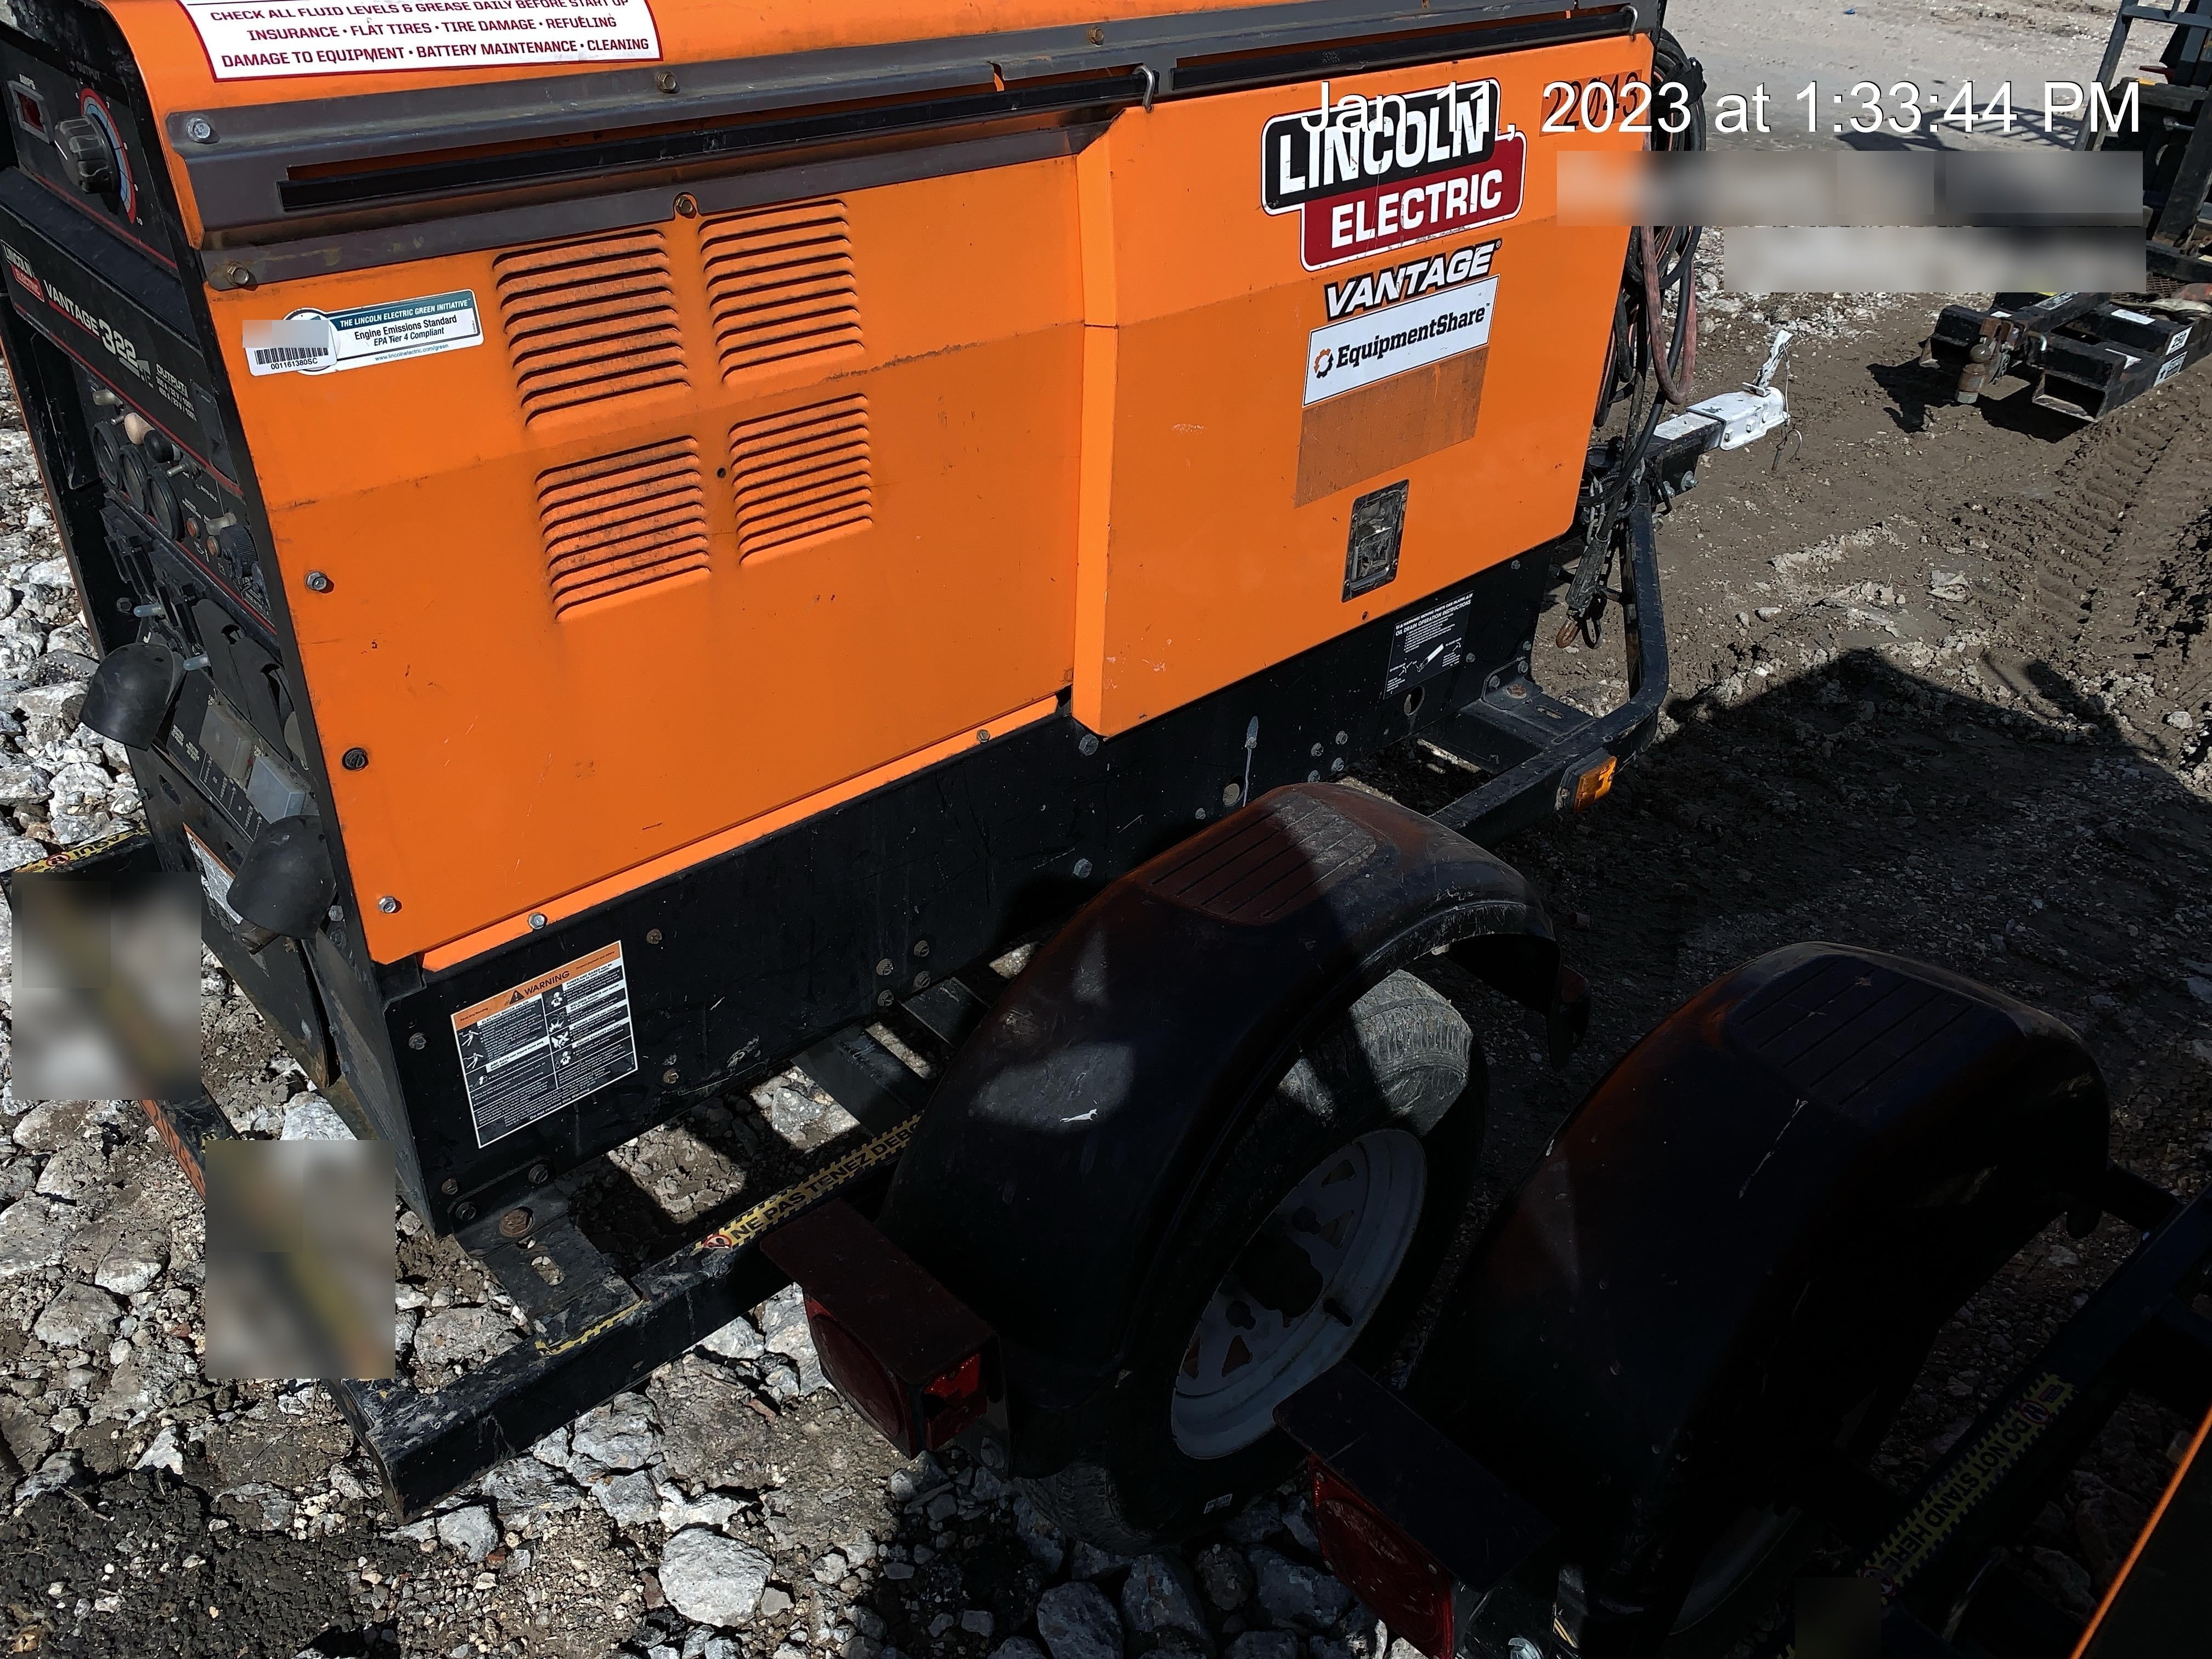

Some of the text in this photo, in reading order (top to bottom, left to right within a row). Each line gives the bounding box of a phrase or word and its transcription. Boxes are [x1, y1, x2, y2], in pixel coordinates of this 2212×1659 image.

[211, 10, 265, 20] CHECK
[269, 8, 296, 19] ALL
[299, 7, 343, 17] FLUID
[347, 4, 399, 15] LEVELS
[402, 3, 413, 12] &
[416, 2, 471, 12] GREASE
[475, 1, 513, 10] DAILY
[517, 0, 567, 8] BEFORE
[247, 17, 617, 41] INSURANCE FLAT TIRES TIRE DAMAGE REFUELING
[222, 38, 649, 67] DAMAGE TO EQUIPMENT BATTERY MAINTENANCE CLEANING
[1279, 98, 1484, 195] LINCOLN
[1331, 169, 1503, 249] ELECTRIC
[1327, 243, 1494, 318] VANTAGE
[43, 279, 139, 369] VANTAGE 322
[340, 300, 468, 328] THE LINCOLN ELECTRIC GREEN INITIATIVE
[355, 328, 381, 341] Engine
[383, 321, 421, 336] Emissions
[423, 315, 457, 329] Standard
[374, 337, 387, 346] EPA
[388, 334, 402, 343] Tier
[410, 327, 444, 341] Compliant
[1336, 306, 1486, 368] EquipmentShare
[156, 363, 186, 393] OUTPUT
[1403, 622, 1417, 633] DRAIN
[1418, 612, 1442, 627] OPERATION
[1442, 599, 1471, 616] INSTRUCTIONS
[524, 969, 570, 996] WARNING
[730, 1215, 765, 1240] NE
[764, 1193, 806, 1221] PAS
[805, 1155, 874, 1195] TENEZ
[1999, 1414, 2032, 1447] DO
[1971, 1437, 2011, 1478] NOT
[1921, 1469, 1980, 1531] STAND
